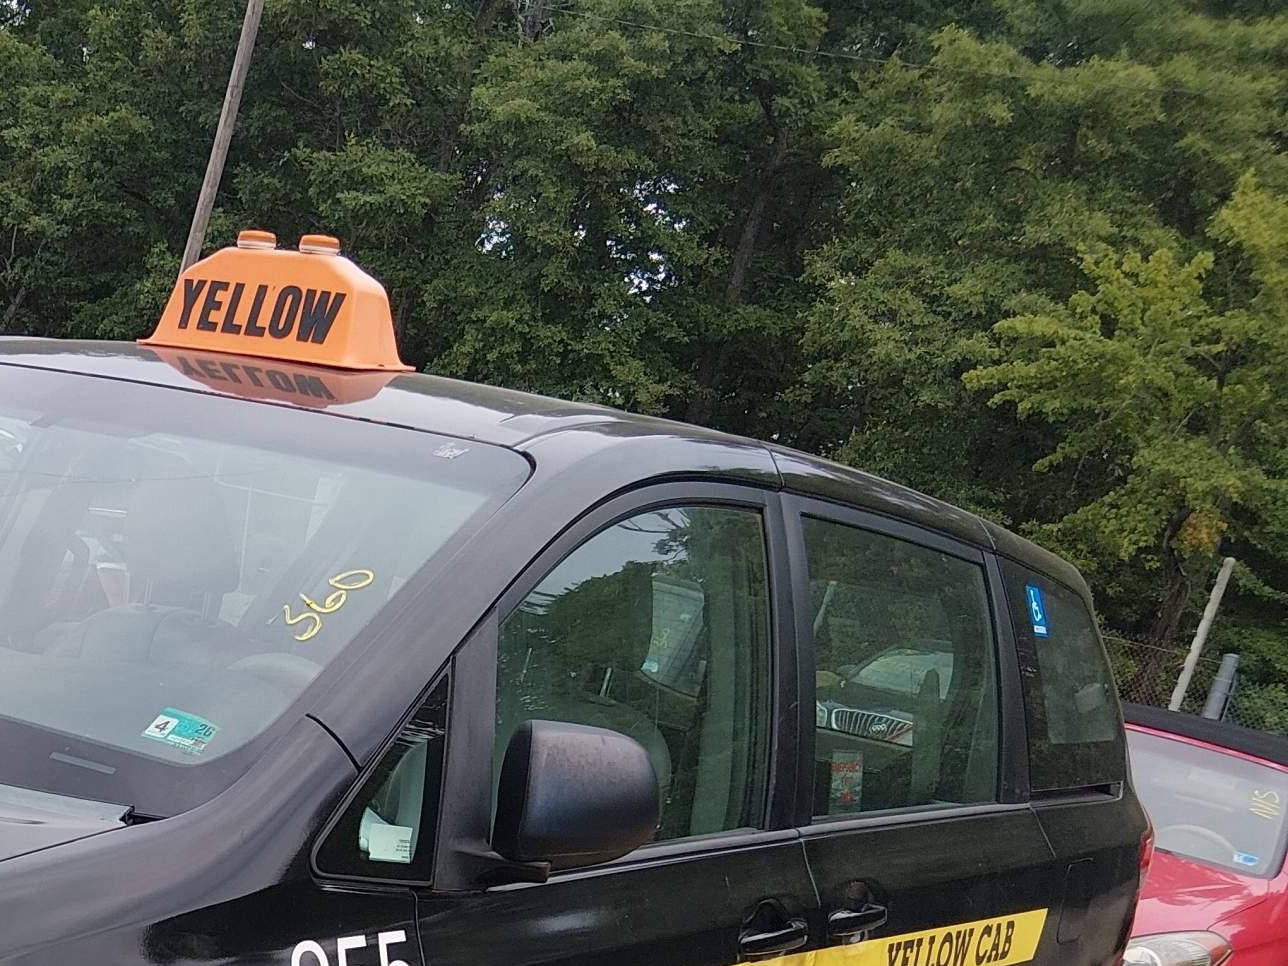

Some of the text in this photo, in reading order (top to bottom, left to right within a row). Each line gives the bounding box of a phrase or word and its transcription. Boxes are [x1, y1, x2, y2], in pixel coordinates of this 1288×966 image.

[177, 278, 347, 345] YELLOW
[283, 569, 374, 641] 560
[155, 721, 170, 732] 4
[975, 920, 1015, 966] CAB
